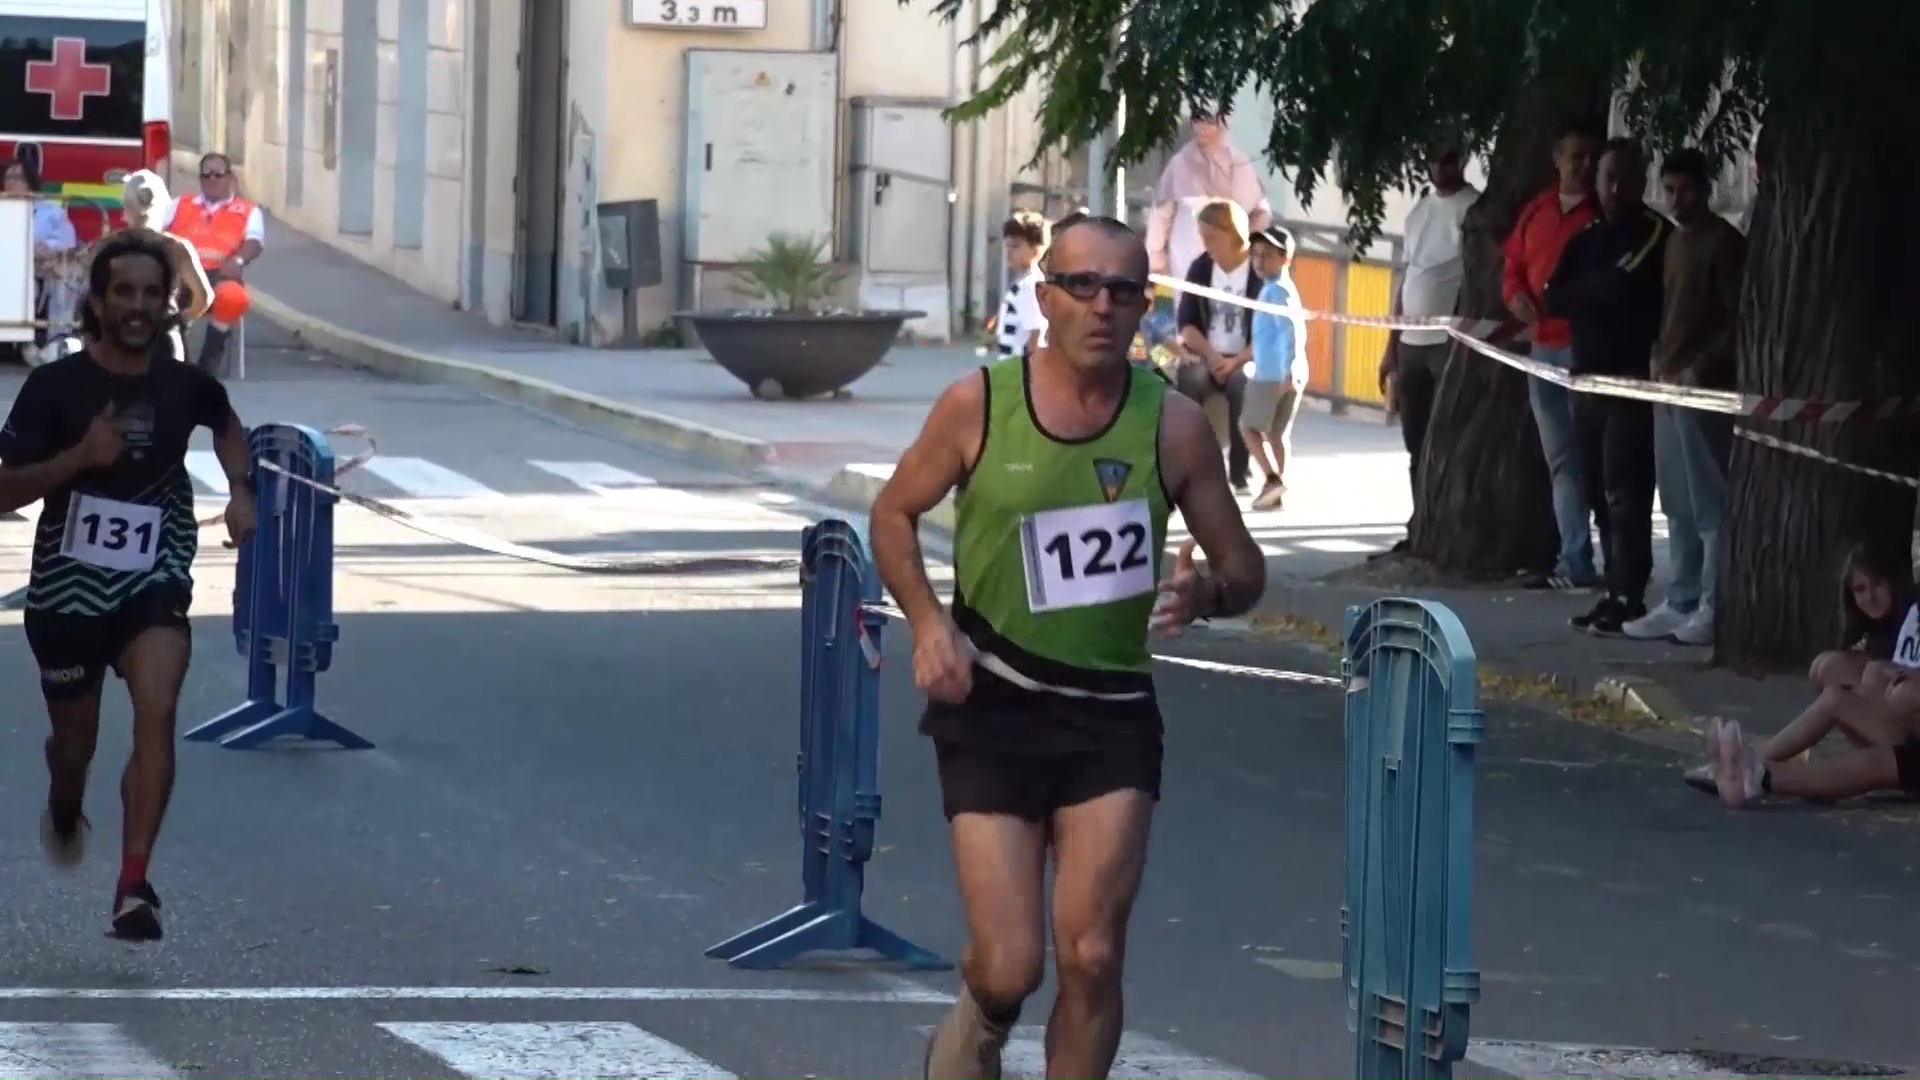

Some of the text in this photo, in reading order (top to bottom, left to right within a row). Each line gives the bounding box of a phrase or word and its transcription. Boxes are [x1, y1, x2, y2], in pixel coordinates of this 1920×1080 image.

[713, 5, 738, 23] m
[82, 513, 153, 554] 131
[1044, 521, 1148, 580] 122
